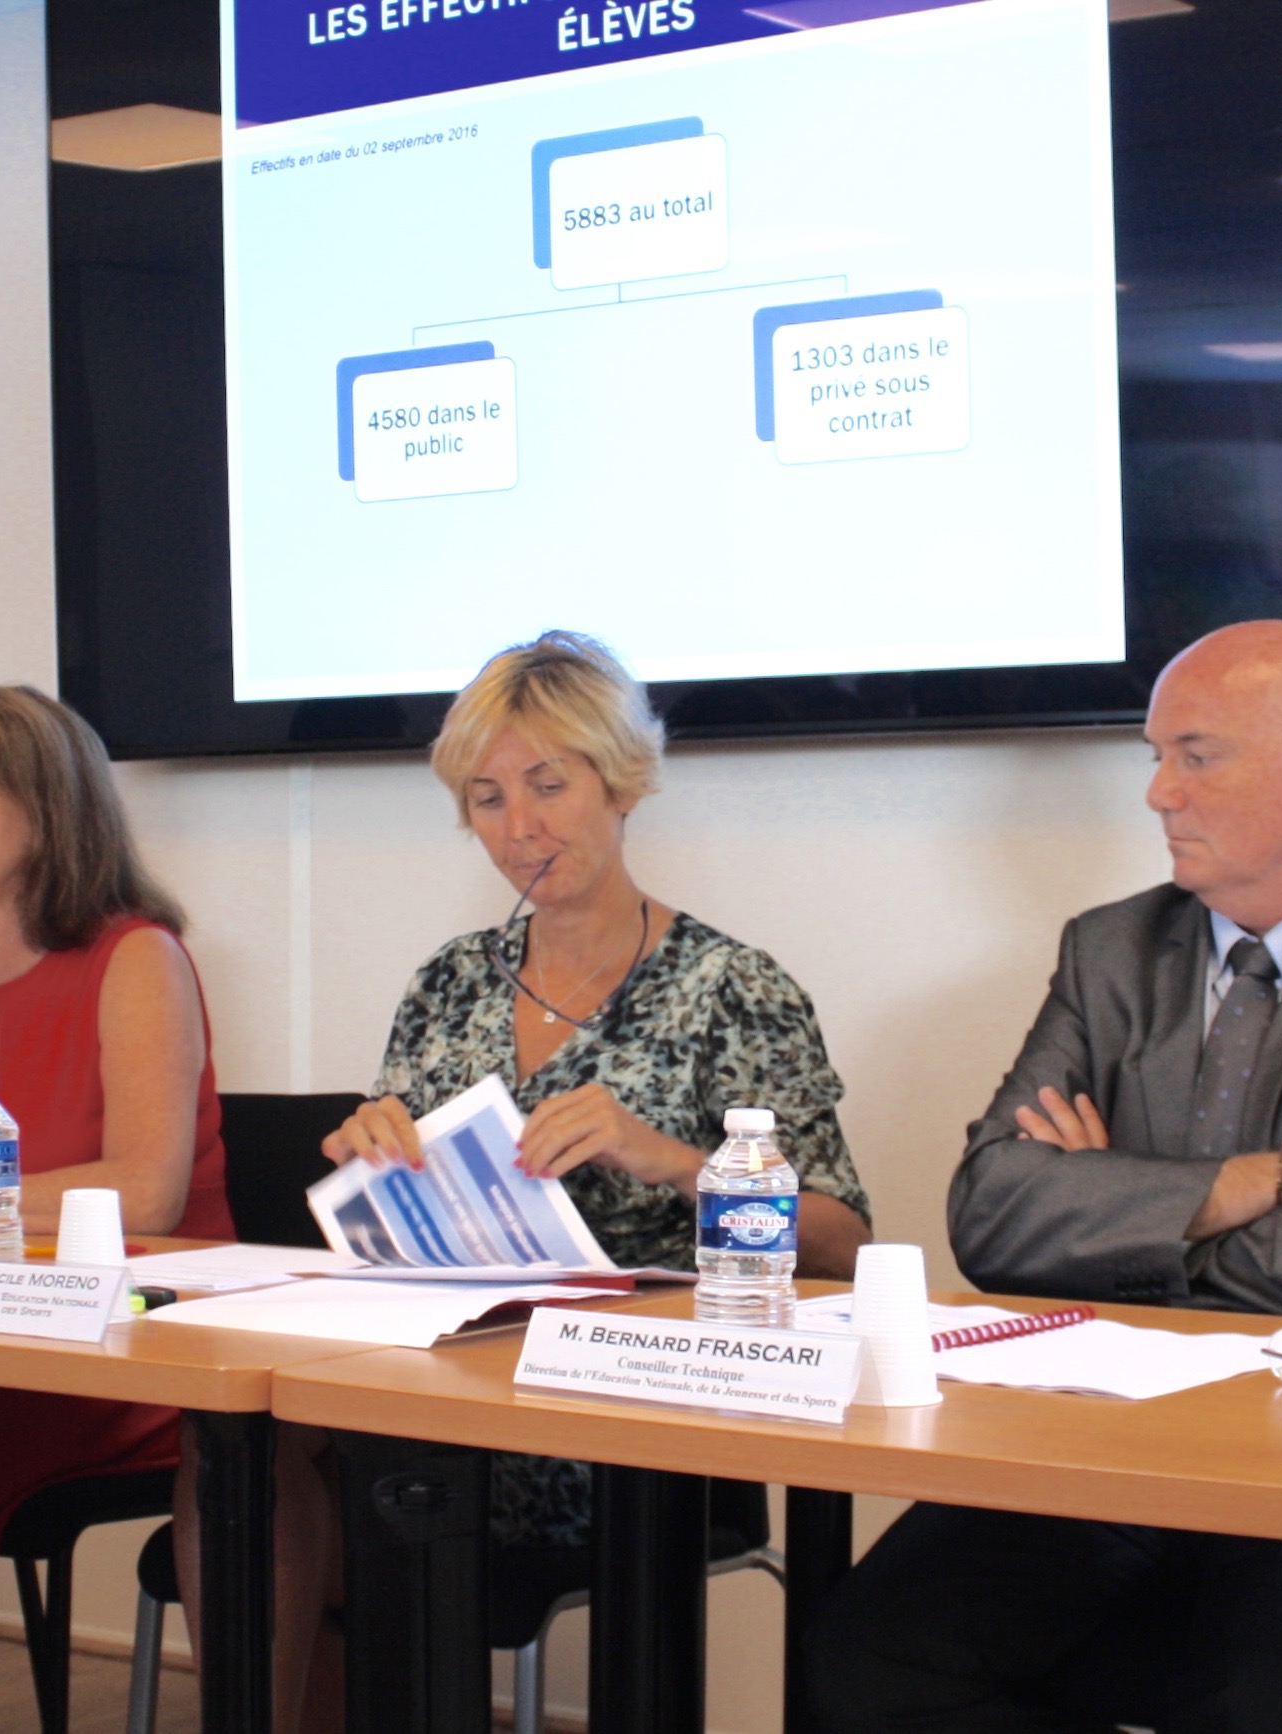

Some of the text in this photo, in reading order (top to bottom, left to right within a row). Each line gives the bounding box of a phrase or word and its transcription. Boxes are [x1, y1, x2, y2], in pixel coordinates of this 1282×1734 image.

[308, 4, 368, 45] LES
[557, 0, 696, 52] ÉLÈVES
[250, 123, 479, 176] Effectifs en date du 02 septembre 2016
[564, 189, 713, 232] 5883 au total
[791, 336, 949, 372] 1303 dans le
[811, 374, 931, 407] privé sous
[368, 399, 501, 431] 4580 dans le
[829, 407, 913, 434] contrat
[404, 432, 464, 462] public
[28, 1272, 101, 1292] MORENO
[1, 1306, 18, 1316] DES
[20, 1306, 53, 1318] SPORTS
[558, 1323, 823, 1368] M. BERNARD FRASCARI
[523, 1362, 568, 1378] Direction
[570, 1368, 583, 1380] de
[643, 1376, 695, 1394] Nationale,
[696, 1383, 710, 1395] de
[711, 1384, 721, 1396] la
[722, 1386, 769, 1401] Jeunesse
[770, 1391, 781, 1402] et
[782, 1392, 800, 1405] des
[801, 1394, 838, 1410] Sports
[617, 1355, 745, 1384] Conseiller Technique
